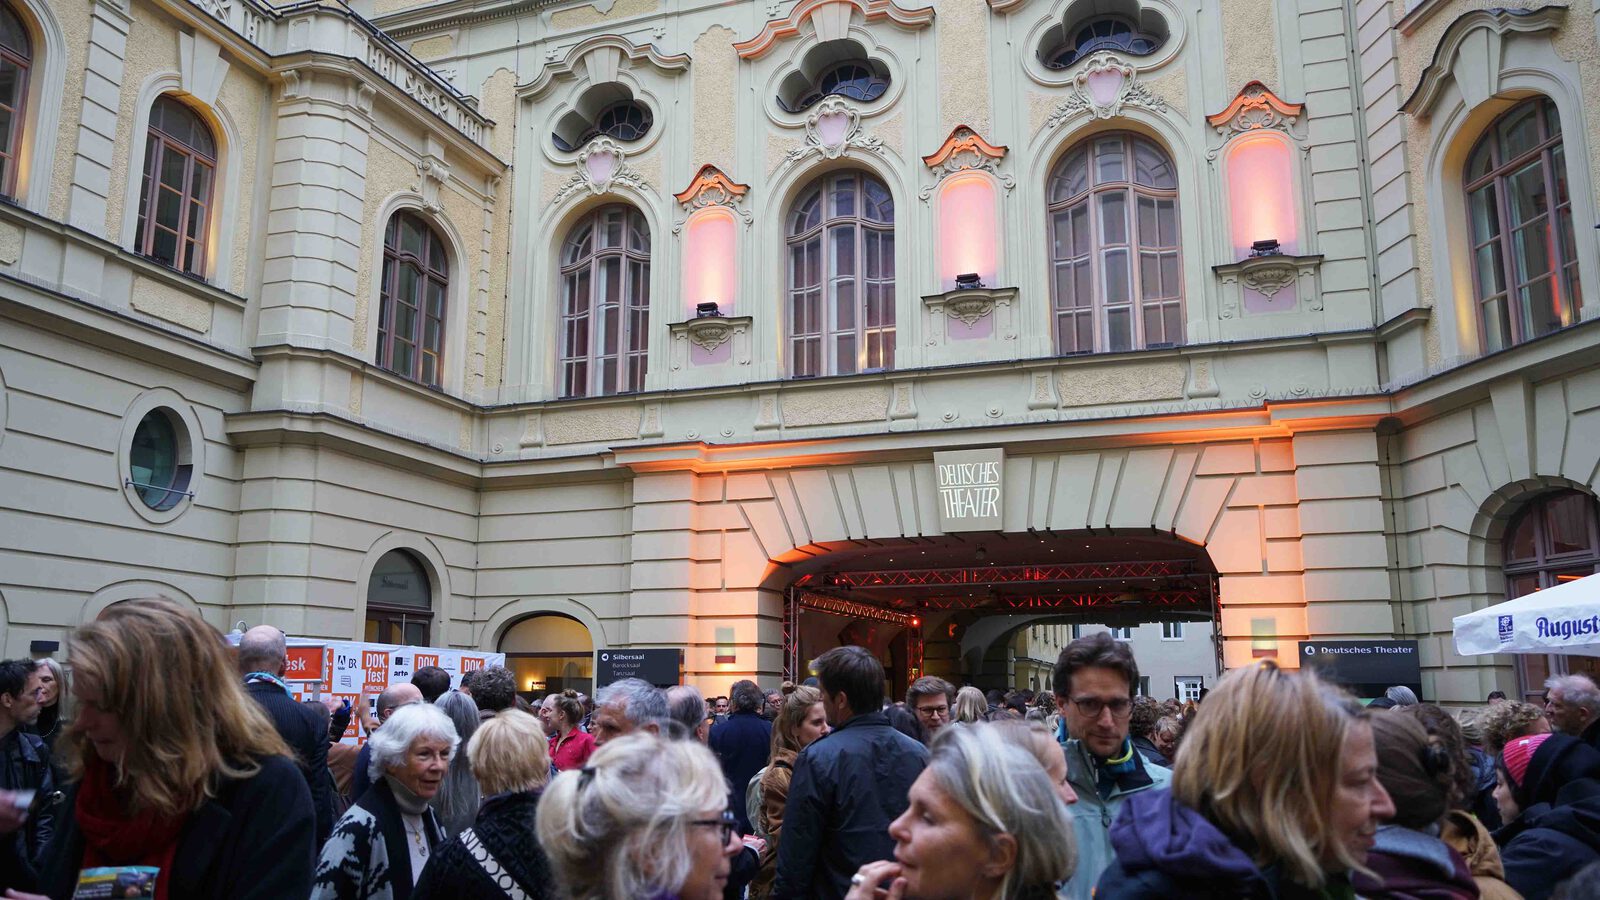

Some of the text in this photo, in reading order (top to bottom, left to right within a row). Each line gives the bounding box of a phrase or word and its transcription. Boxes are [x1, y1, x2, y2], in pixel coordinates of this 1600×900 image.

[939, 462, 999, 486] DEUTSCHES
[940, 487, 1000, 518] THEATER
[1536, 615, 1600, 640] August
[1321, 646, 1413, 655] Deutsches Theater
[285, 656, 306, 671] esk
[348, 658, 357, 668] BR
[366, 653, 388, 668] DOK.
[368, 668, 385, 682] fest
